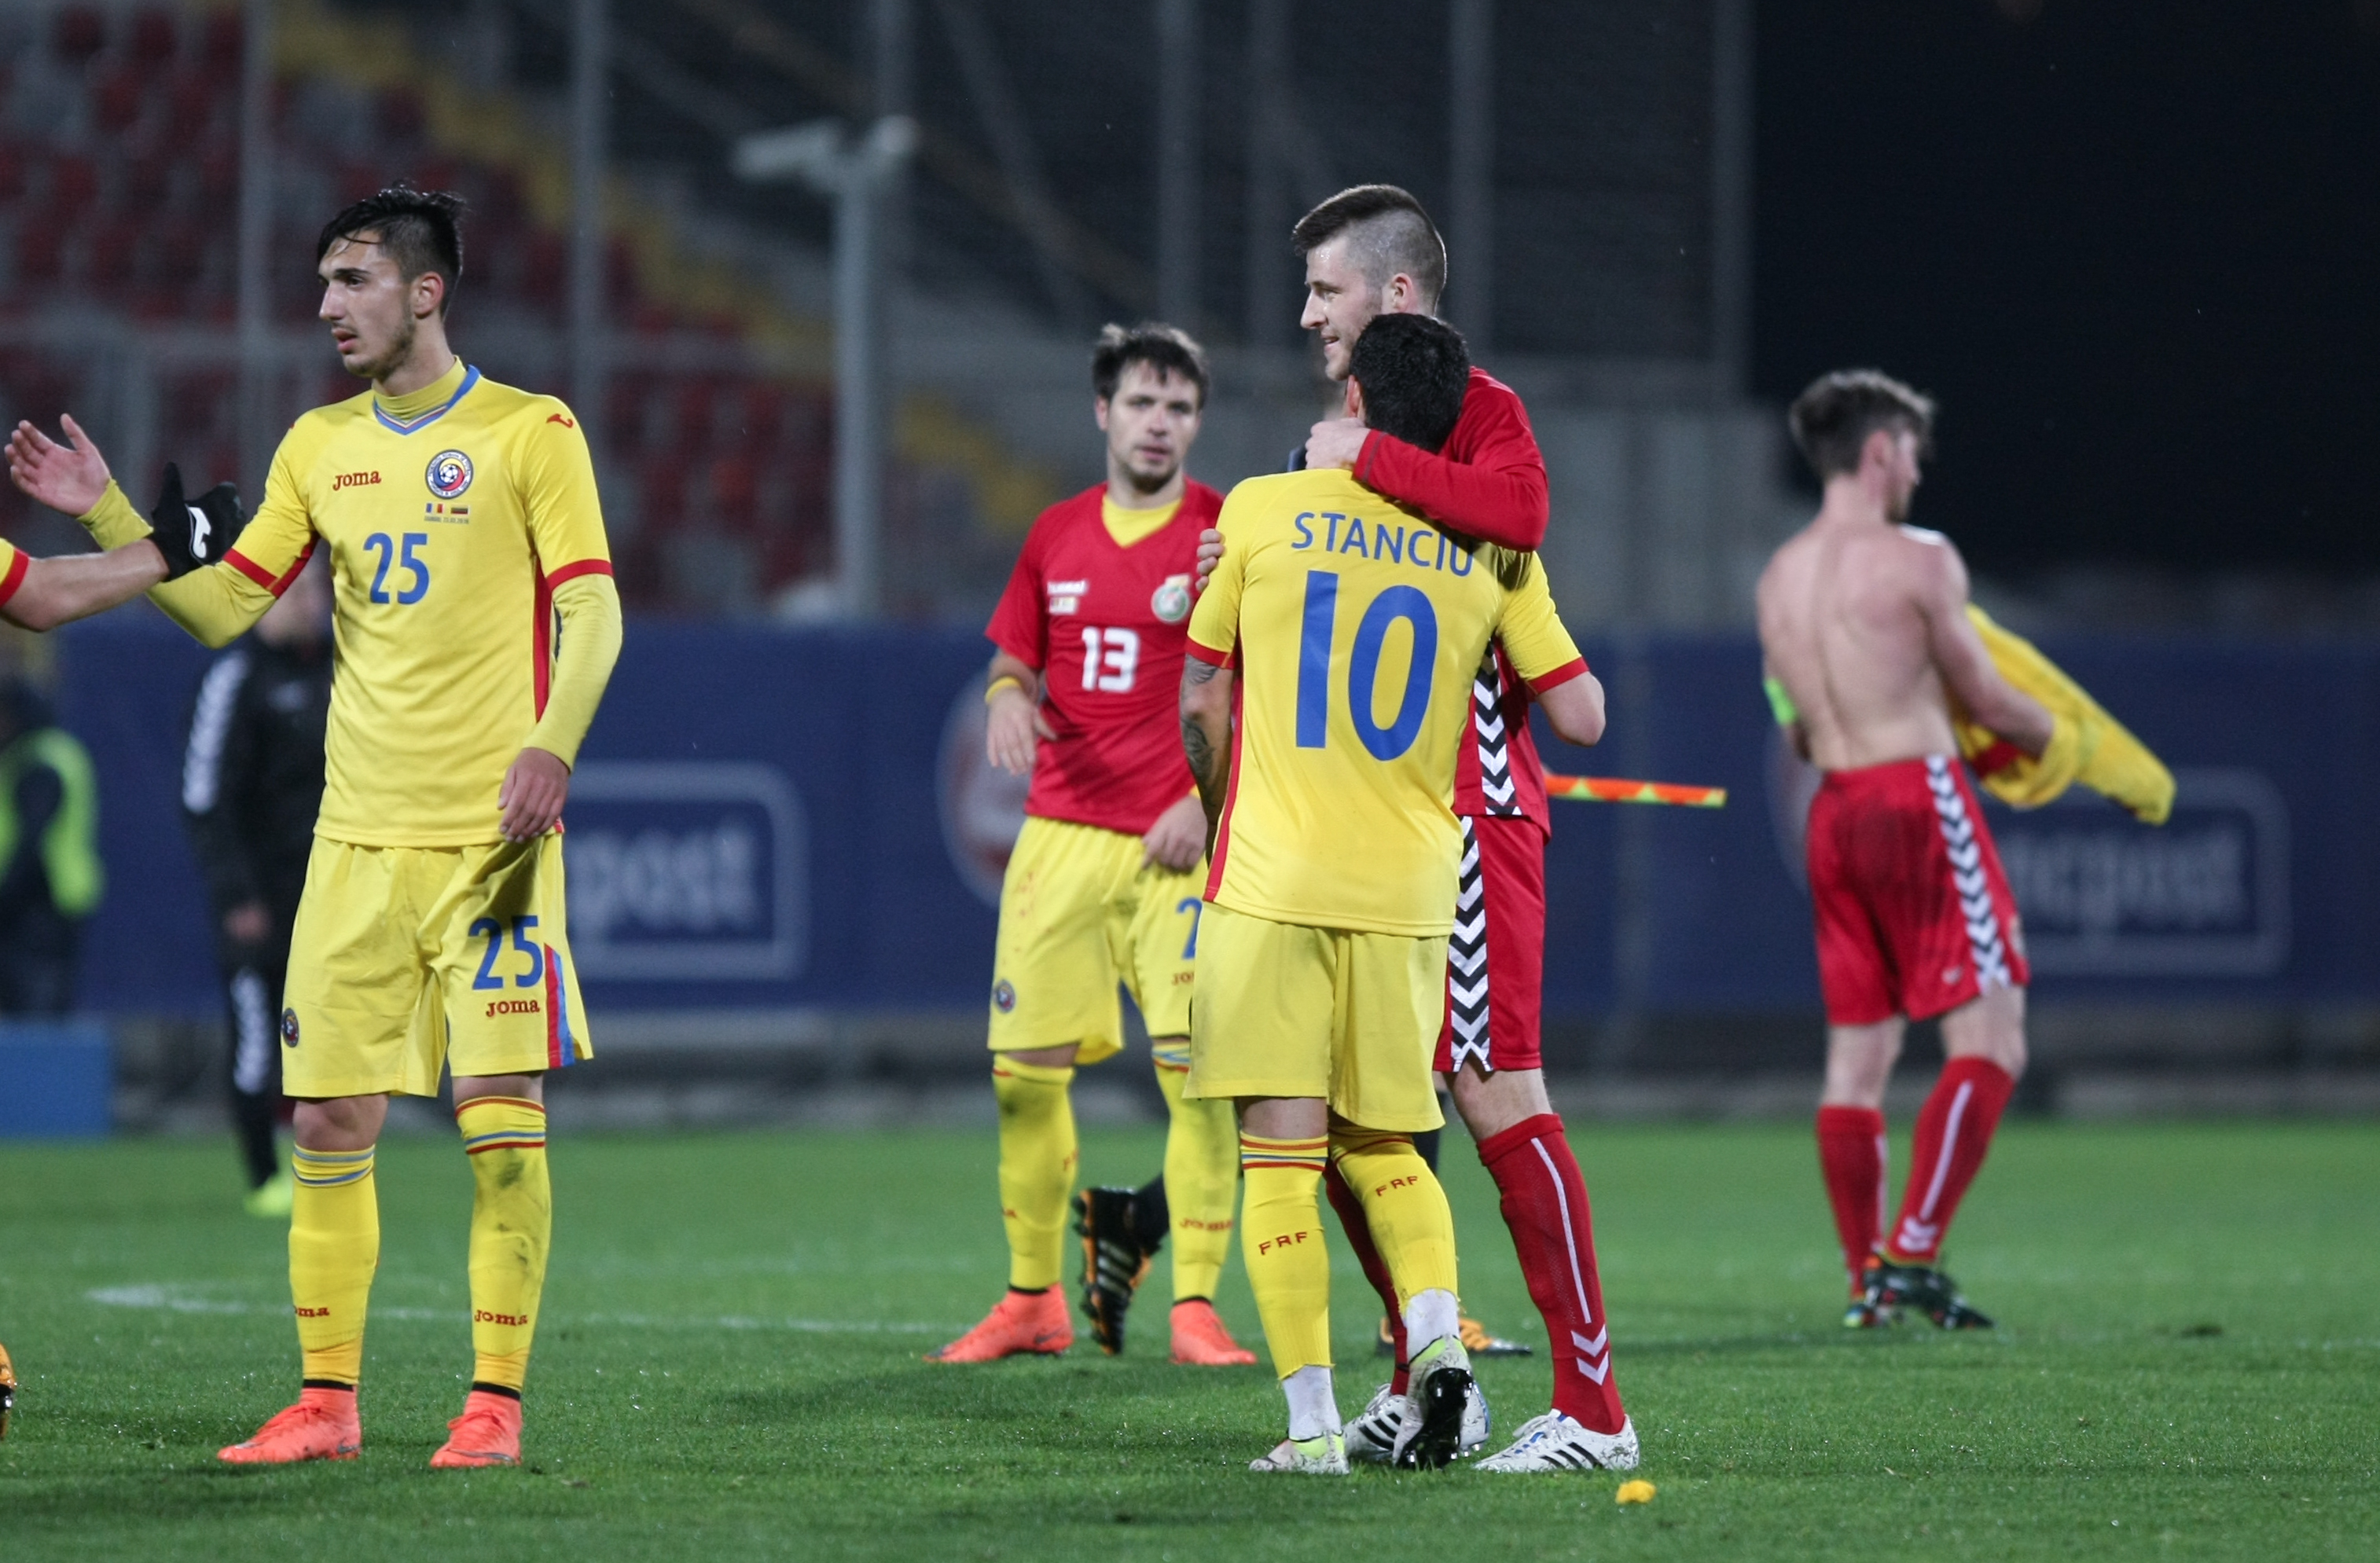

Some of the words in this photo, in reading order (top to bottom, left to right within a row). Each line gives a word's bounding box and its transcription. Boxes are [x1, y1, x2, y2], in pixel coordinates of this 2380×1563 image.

[363, 532, 430, 605] 25
[1291, 512, 1474, 577] STANCIU
[1081, 626, 1140, 693] 13
[1295, 570, 1438, 761] 10
[468, 915, 543, 990] 25
[1376, 1176, 1418, 1197] FRF
[1258, 1231, 1307, 1255] FRF
